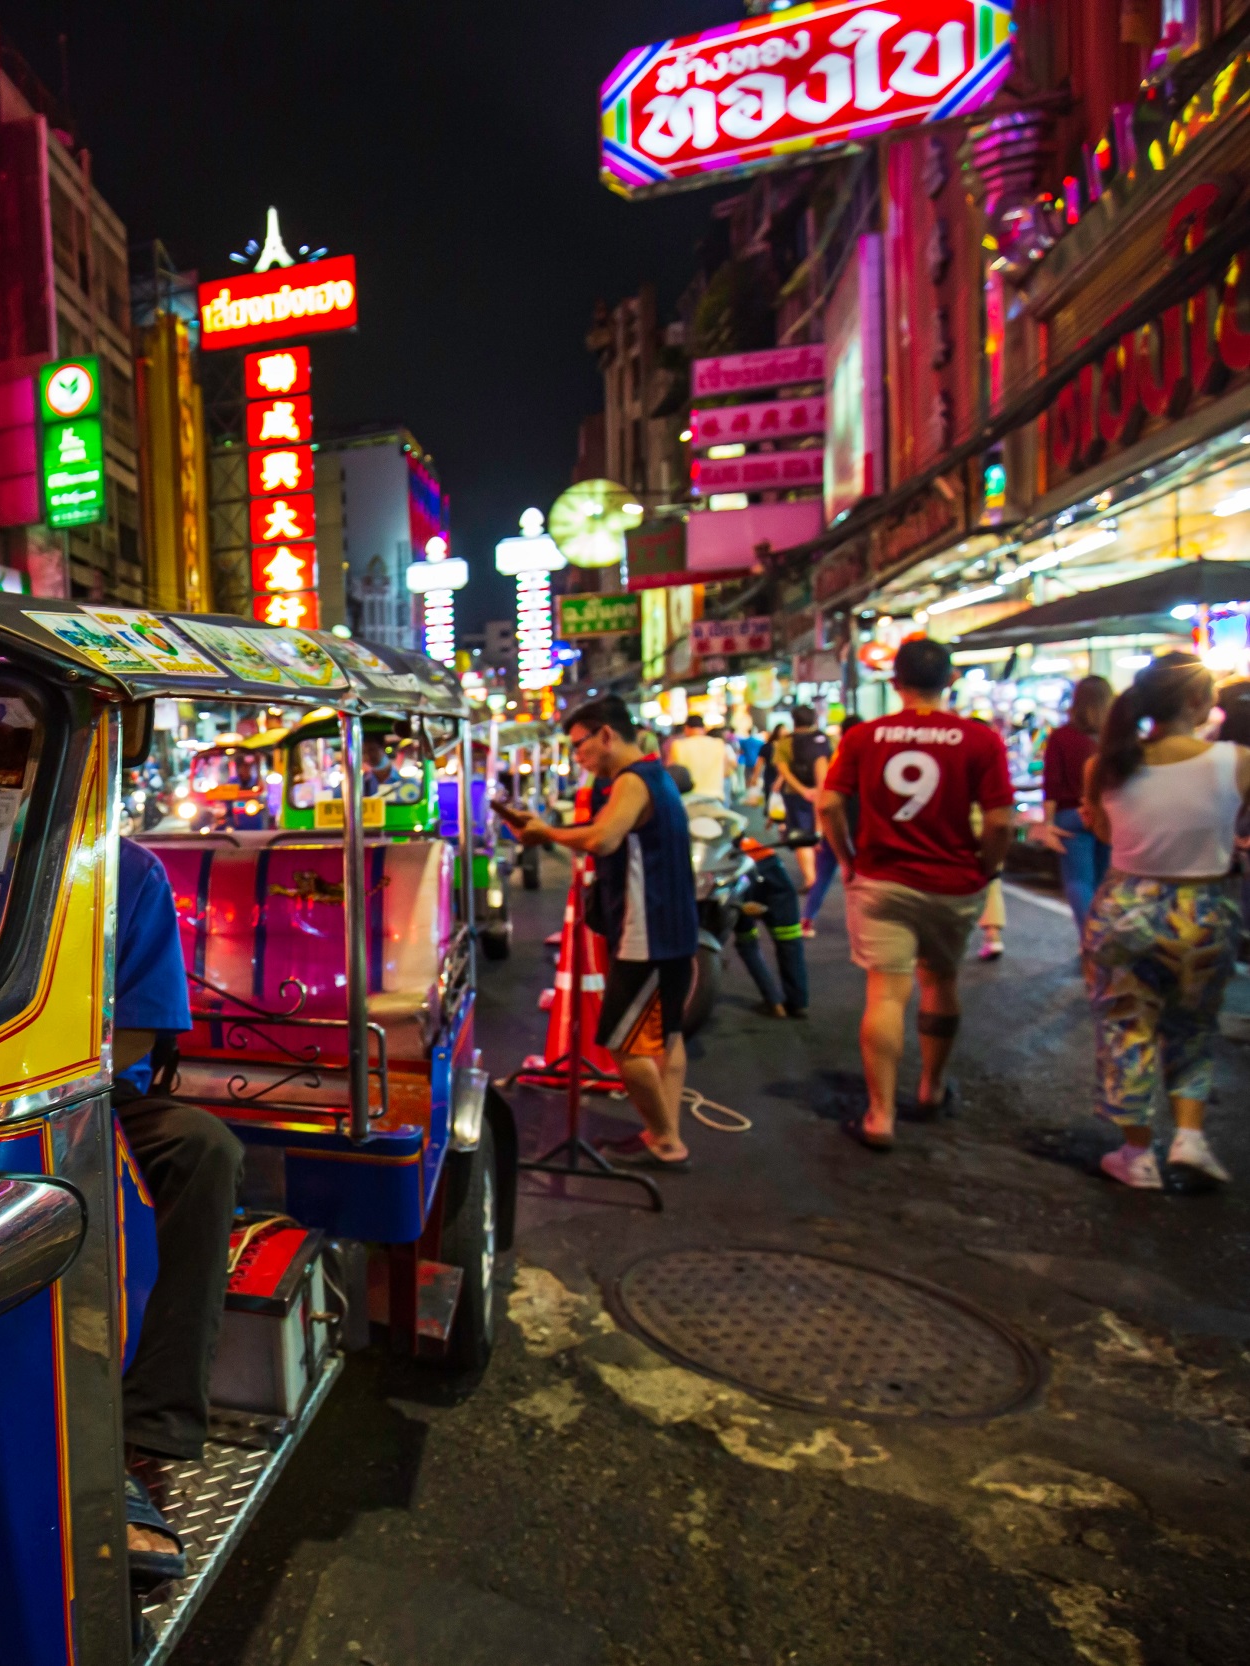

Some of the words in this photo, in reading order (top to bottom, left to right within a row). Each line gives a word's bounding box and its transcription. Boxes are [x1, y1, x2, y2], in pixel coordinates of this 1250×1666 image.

[638, 9, 966, 157] ทองใบ
[655, 30, 811, 92] ห้างทอง
[873, 725, 964, 746] FIRMINO
[883, 750, 940, 822] 9
